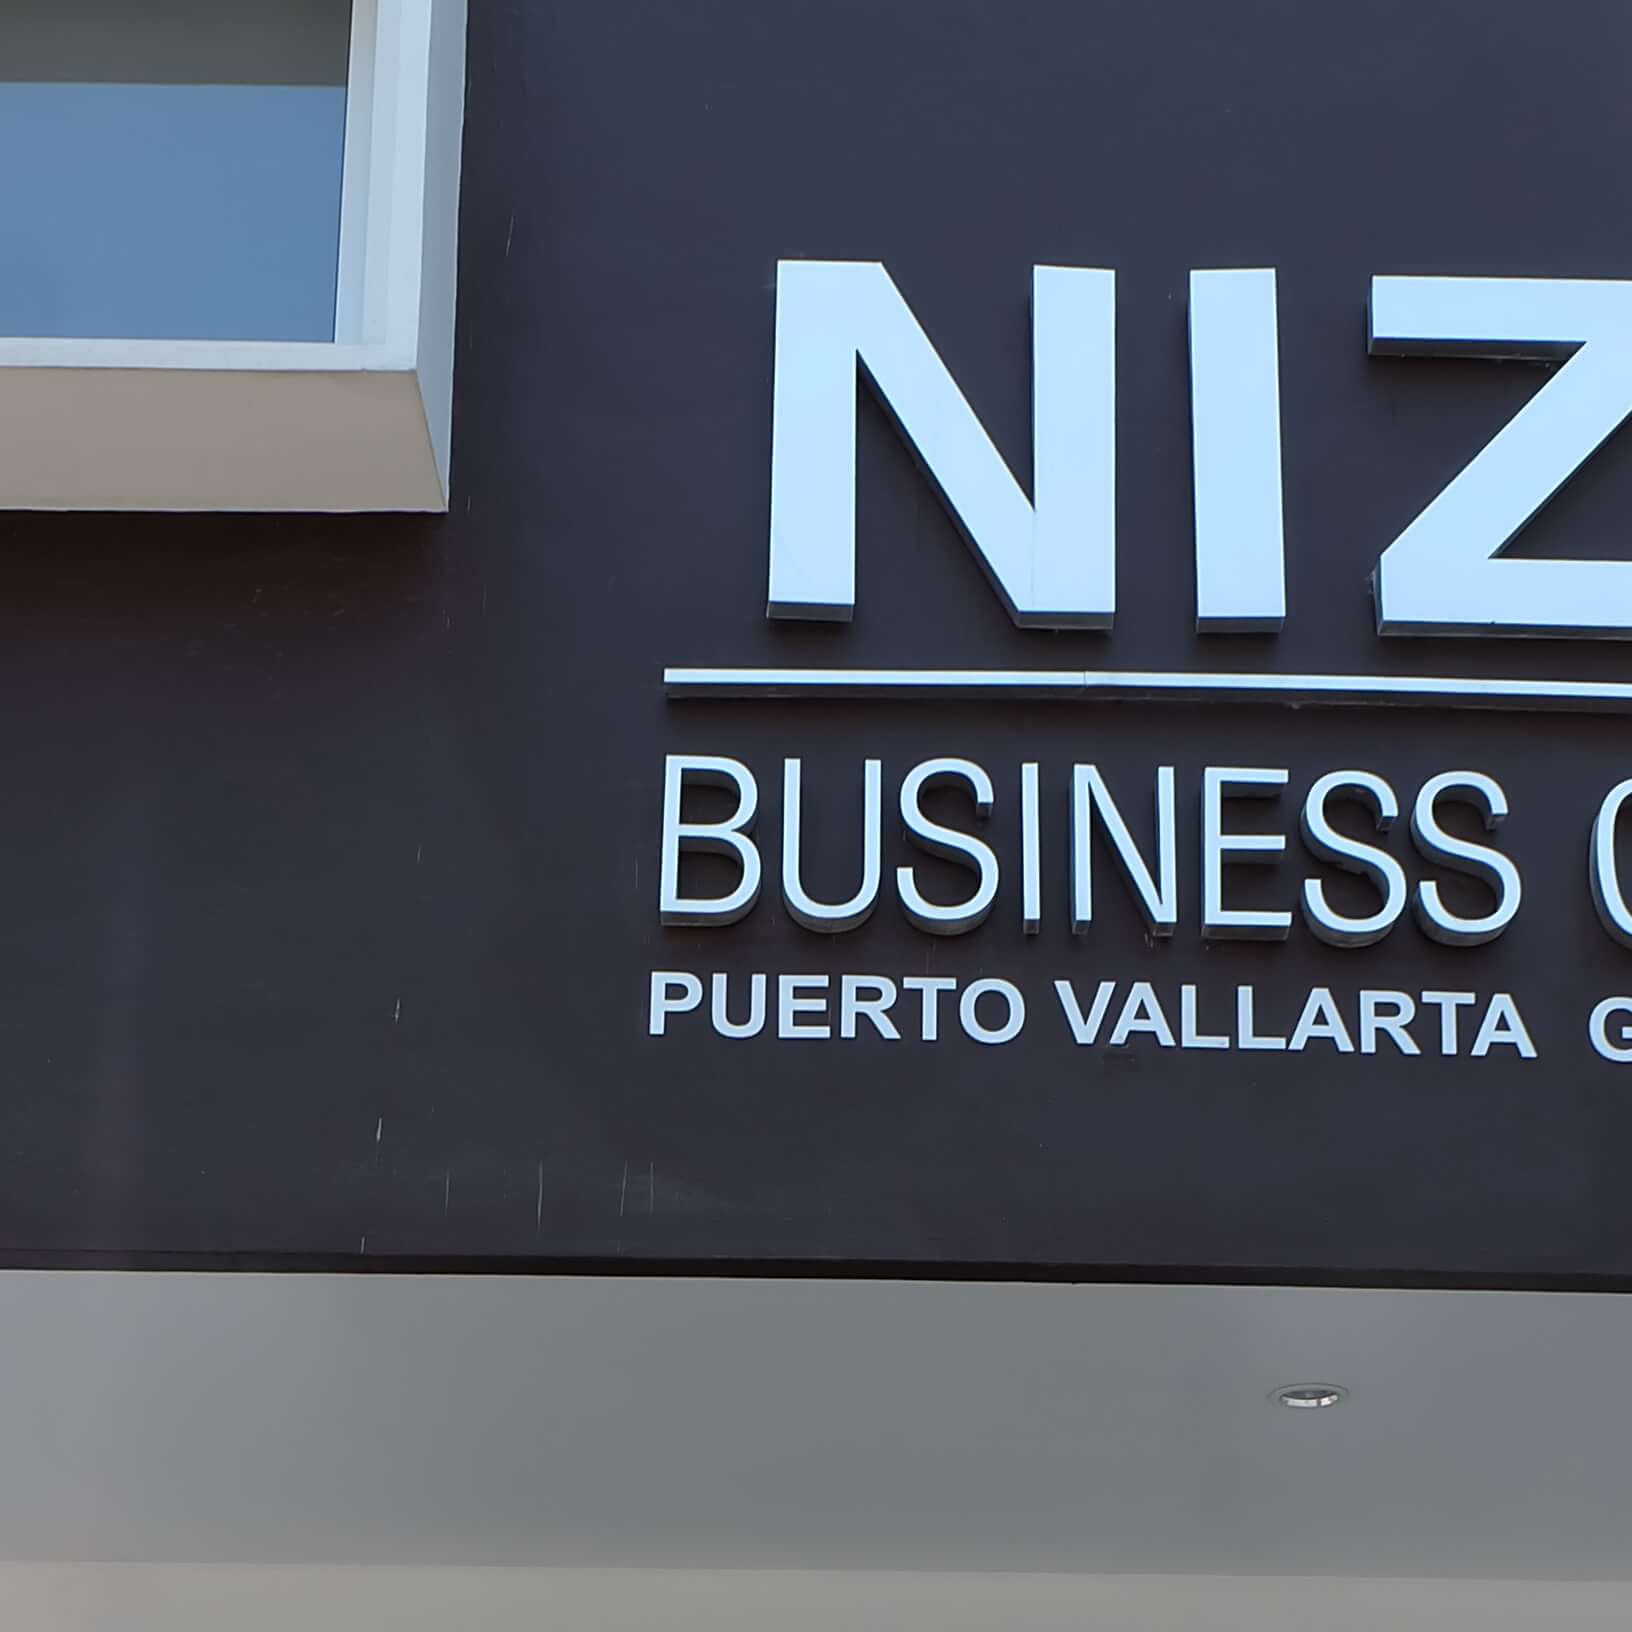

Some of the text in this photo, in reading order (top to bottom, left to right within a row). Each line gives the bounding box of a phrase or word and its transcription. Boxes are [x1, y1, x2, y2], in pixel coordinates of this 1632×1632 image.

[658, 754, 1523, 946] BUSINESS
[649, 970, 1026, 1044] PUERTO
[1053, 979, 1538, 1059] VALLARTA
